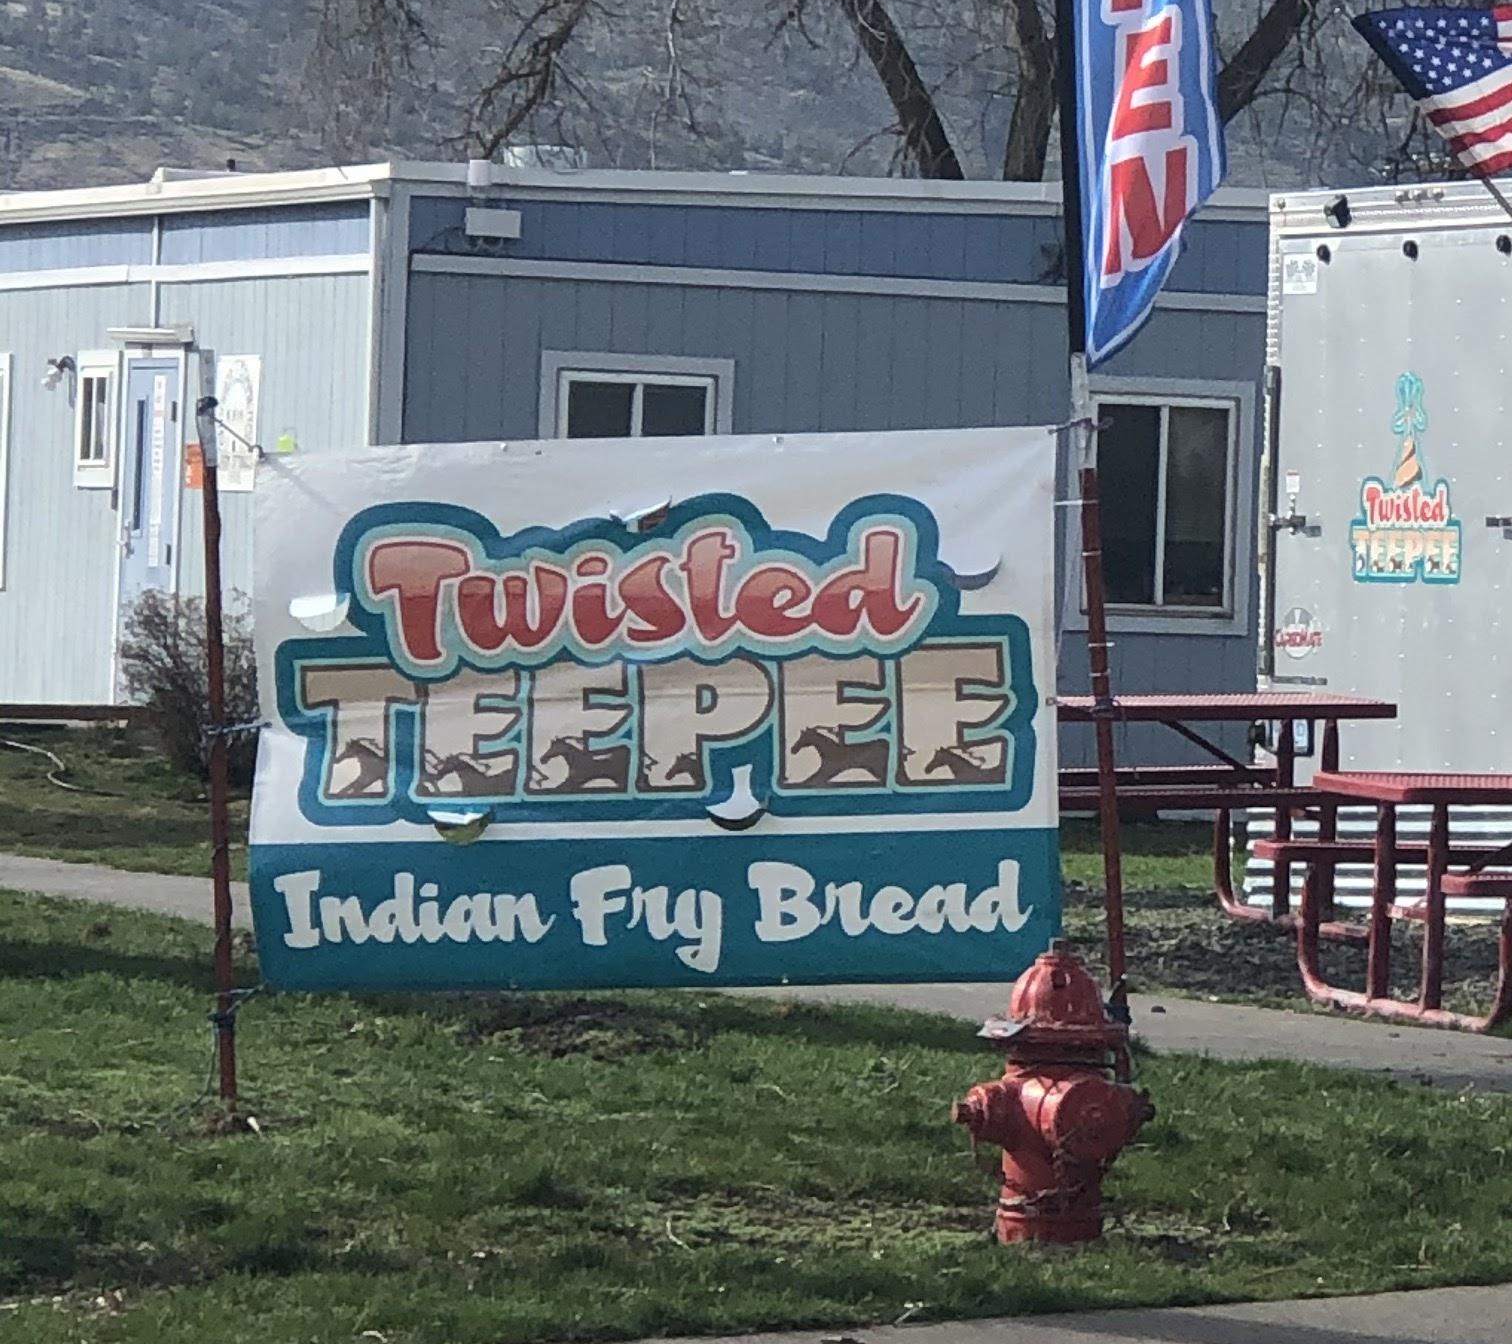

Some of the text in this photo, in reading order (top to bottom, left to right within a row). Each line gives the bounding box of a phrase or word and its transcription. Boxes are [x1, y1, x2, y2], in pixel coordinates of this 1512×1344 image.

[1365, 486, 1445, 525] Twisted
[368, 529, 922, 661] Twisted
[301, 642, 1009, 800] TEEPEE
[274, 858, 1033, 974] Indian Fry Bread
